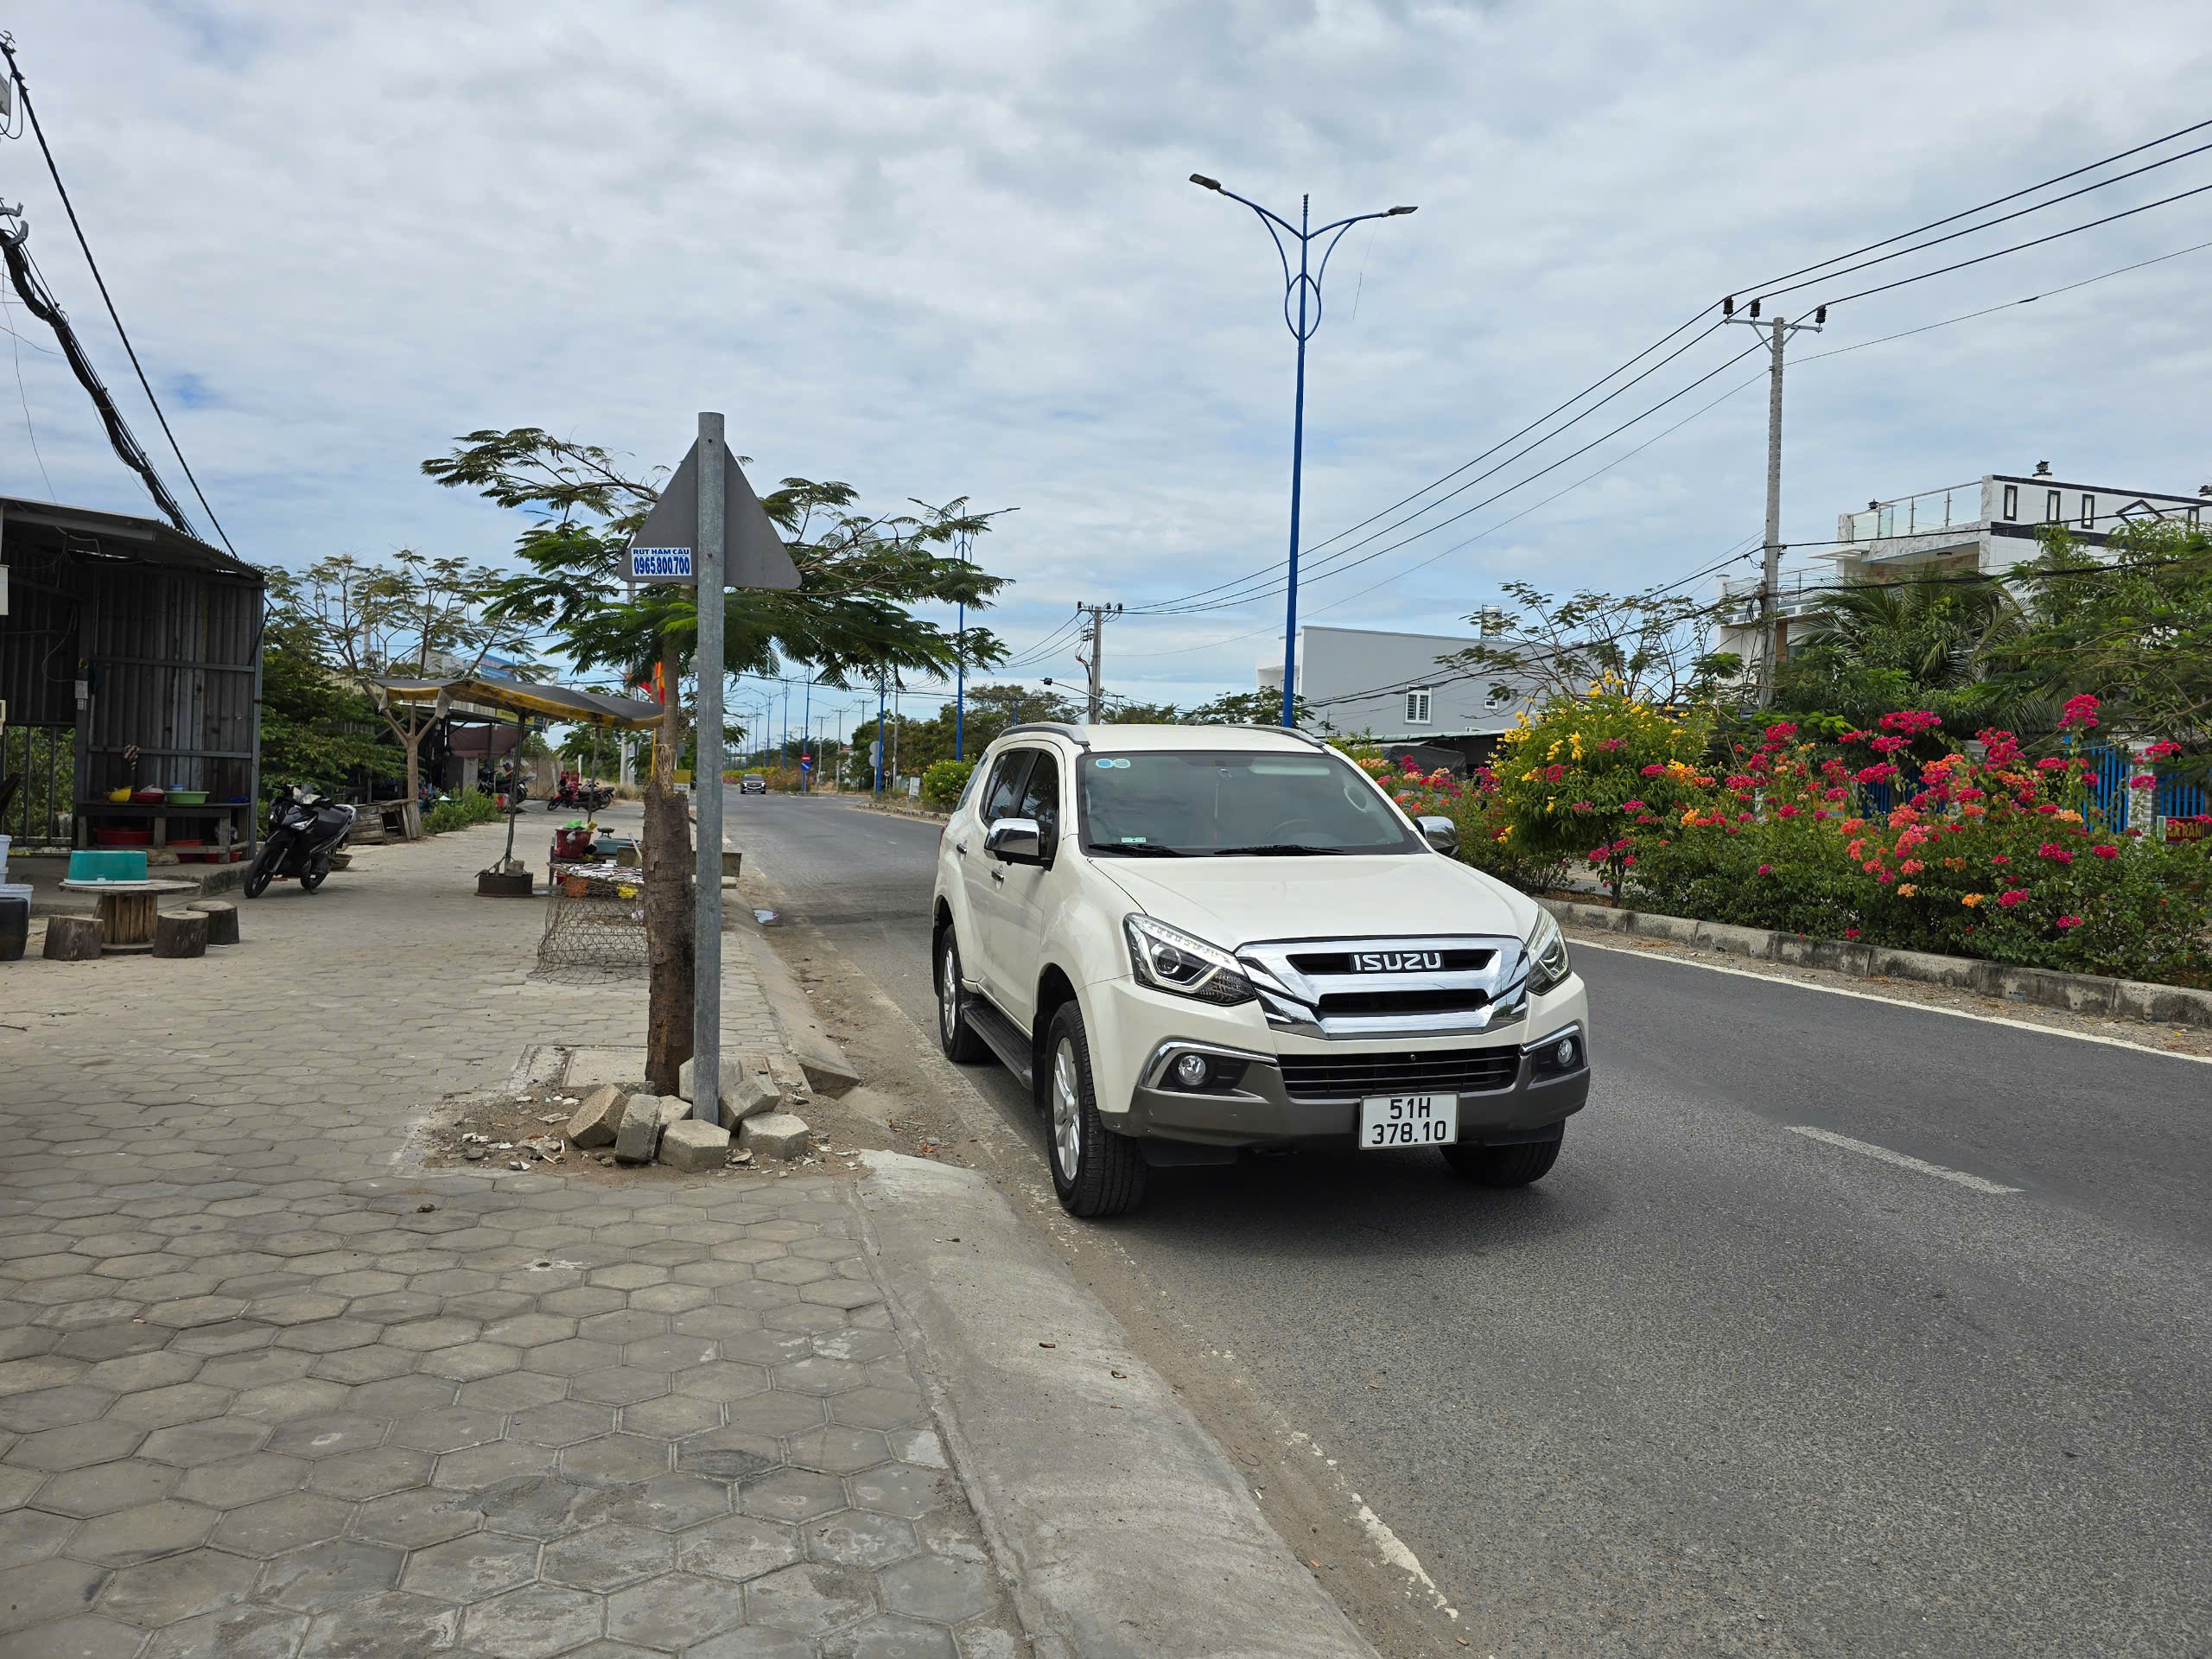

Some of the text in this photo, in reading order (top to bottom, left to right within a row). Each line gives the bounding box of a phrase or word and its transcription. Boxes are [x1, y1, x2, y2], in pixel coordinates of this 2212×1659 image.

[633, 556, 690, 575] 0965.800.700
[1353, 952, 1442, 971] ISUZU
[1389, 1096, 1431, 1120] 51H
[1371, 1120, 1446, 1145] 378.10
